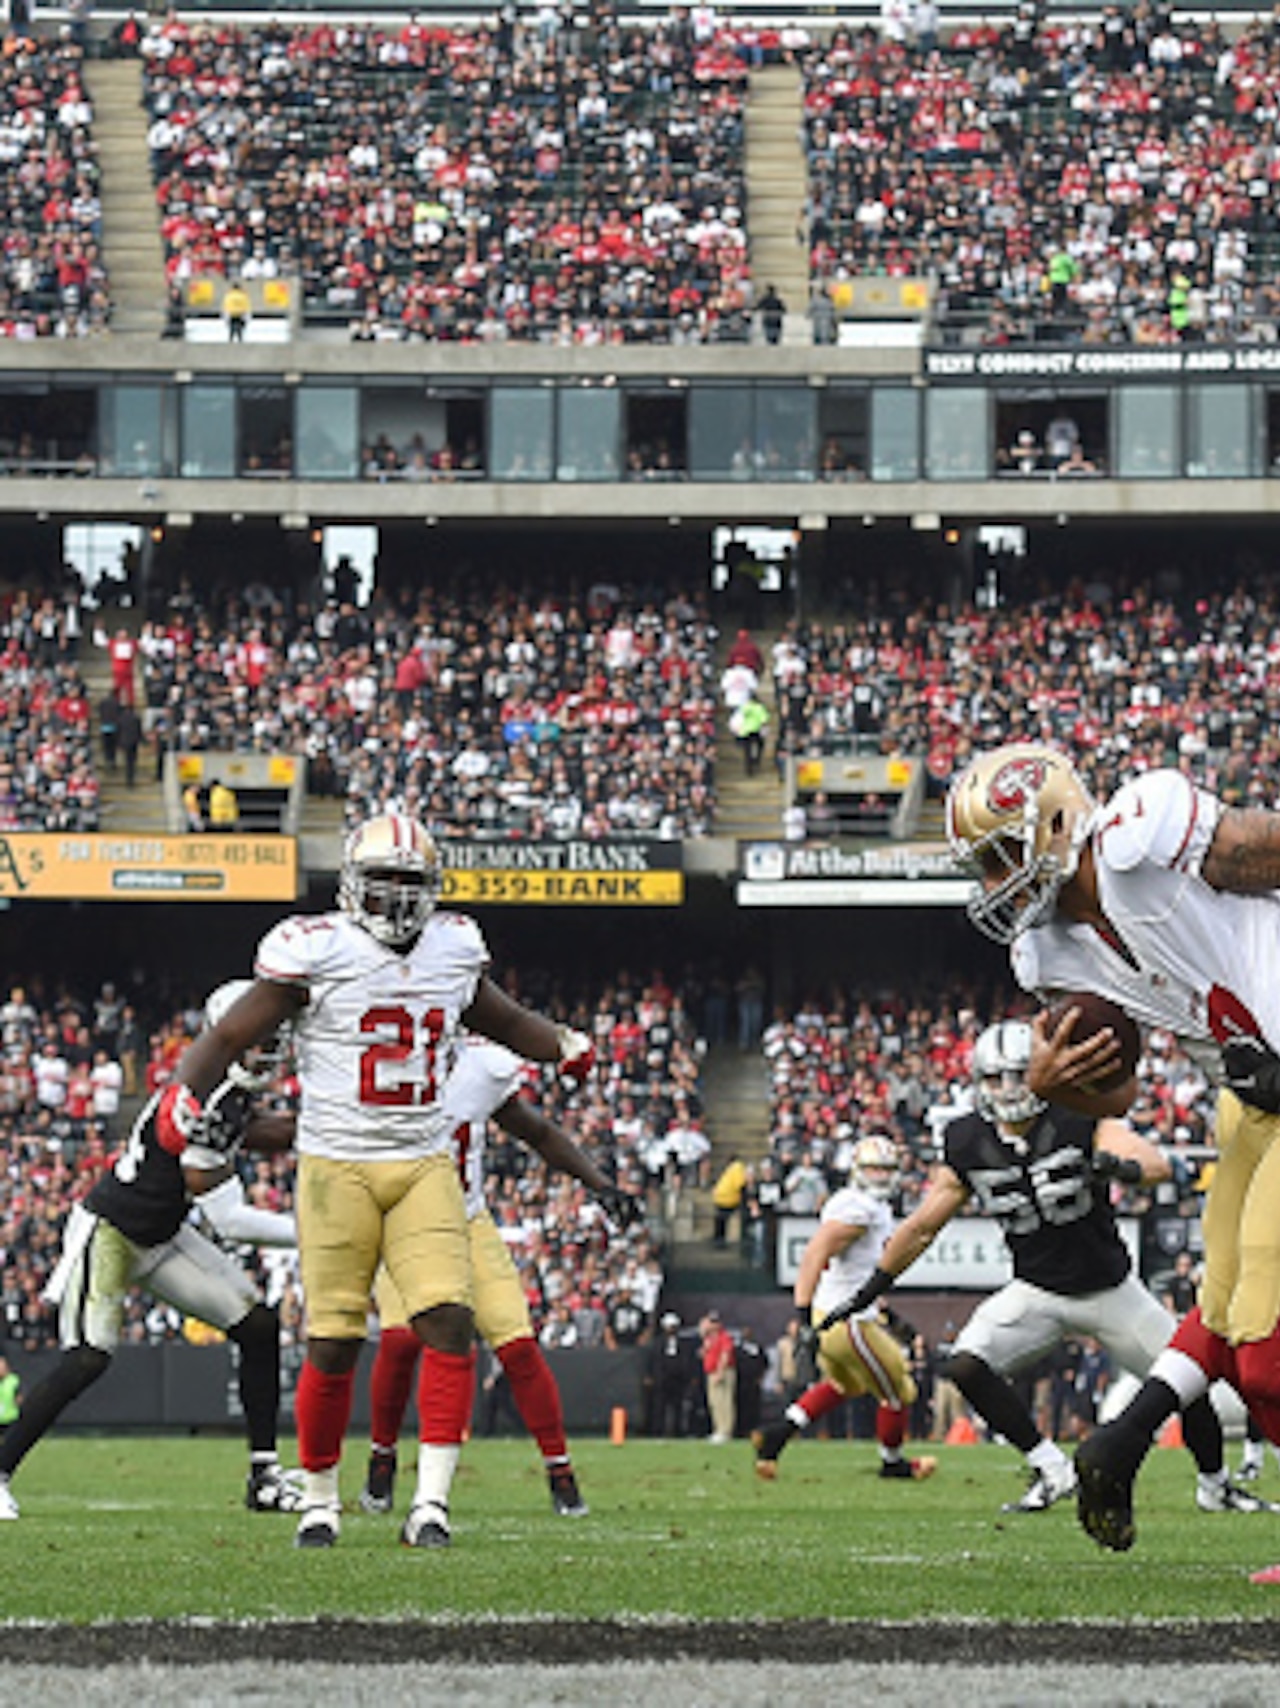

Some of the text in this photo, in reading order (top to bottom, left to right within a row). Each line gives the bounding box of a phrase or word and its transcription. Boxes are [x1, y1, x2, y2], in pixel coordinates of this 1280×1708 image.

[978, 353, 1073, 373] CONDUCT
[1185, 351, 1231, 371] AND
[568, 842, 649, 871] BANK
[359, 1004, 445, 1105] 21
[966, 1144, 1092, 1235] 56
